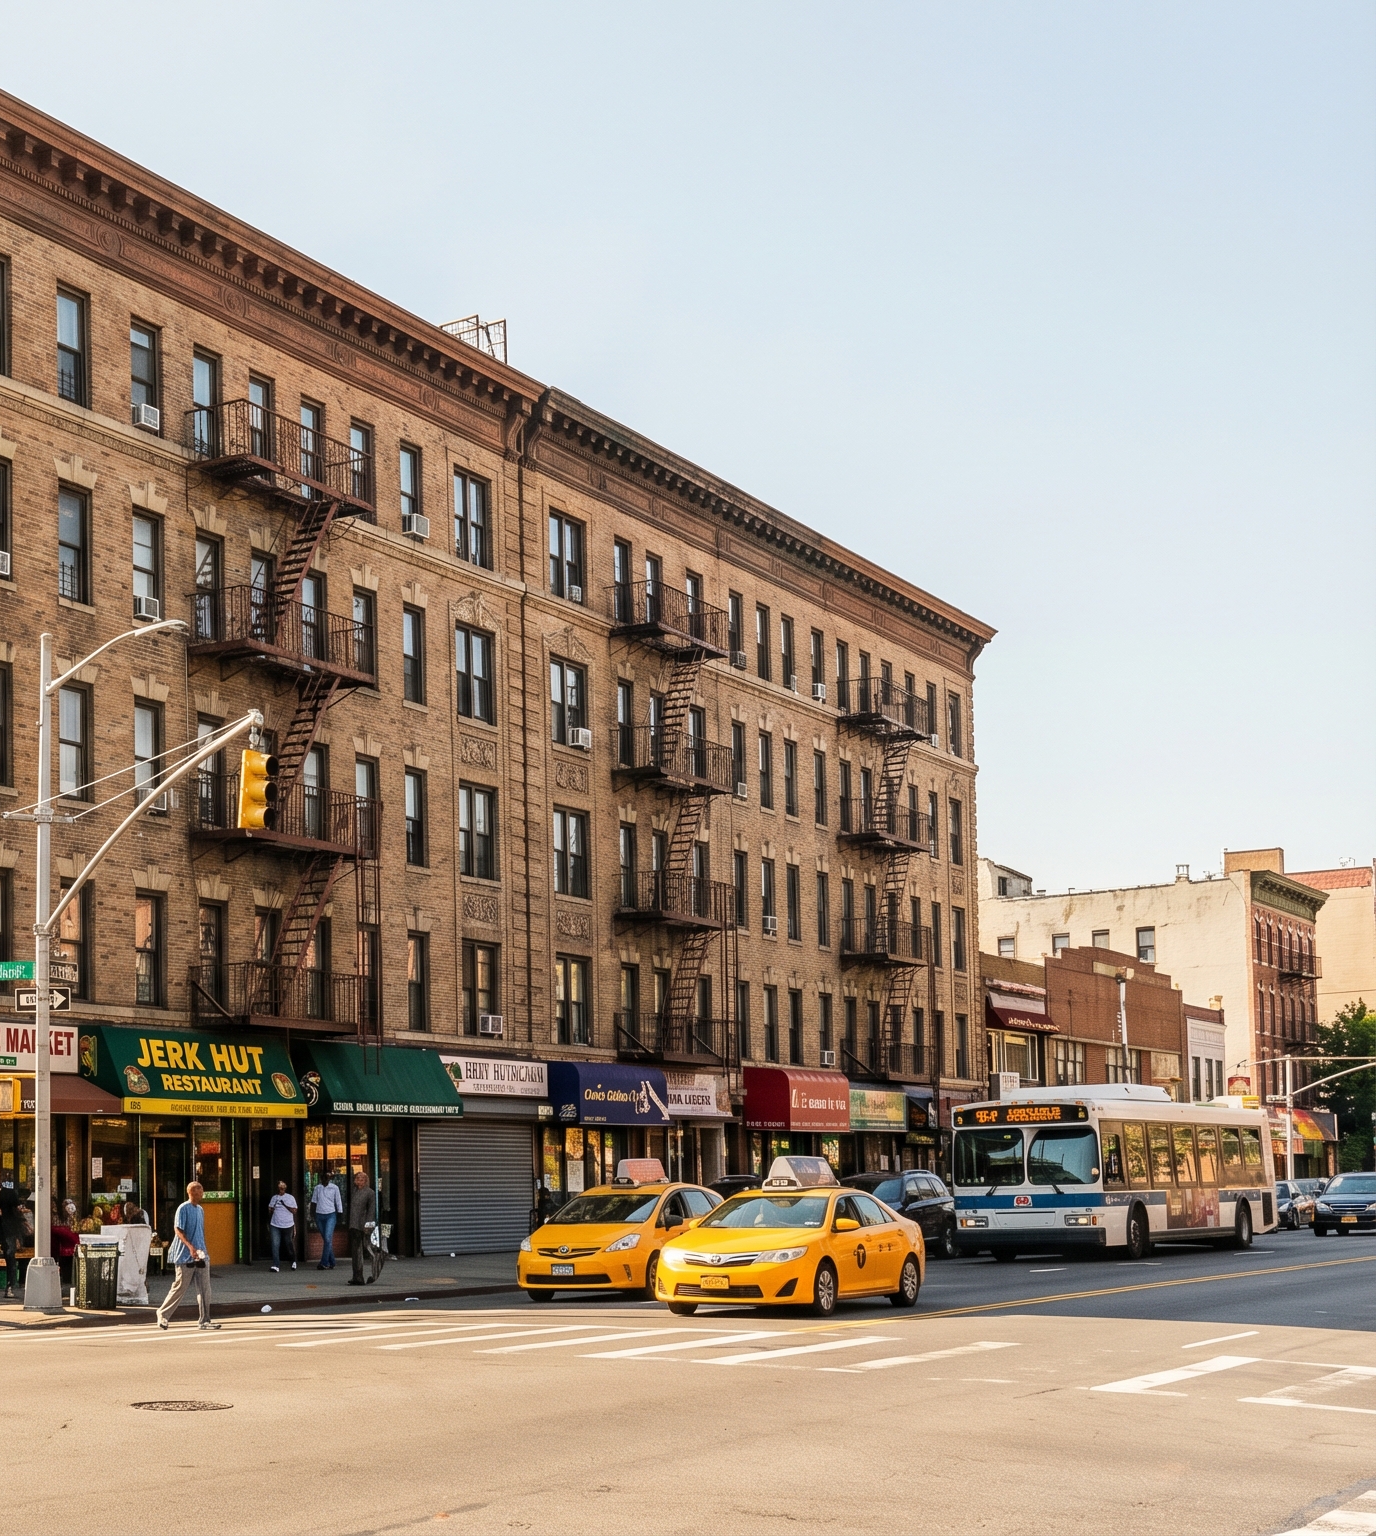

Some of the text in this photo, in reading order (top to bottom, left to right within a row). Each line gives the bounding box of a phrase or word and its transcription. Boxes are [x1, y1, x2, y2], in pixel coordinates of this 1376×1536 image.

[6, 1027, 74, 1056] MAET
[137, 1038, 263, 1074] JERK HUT
[161, 1073, 262, 1095] RESTAURANT
